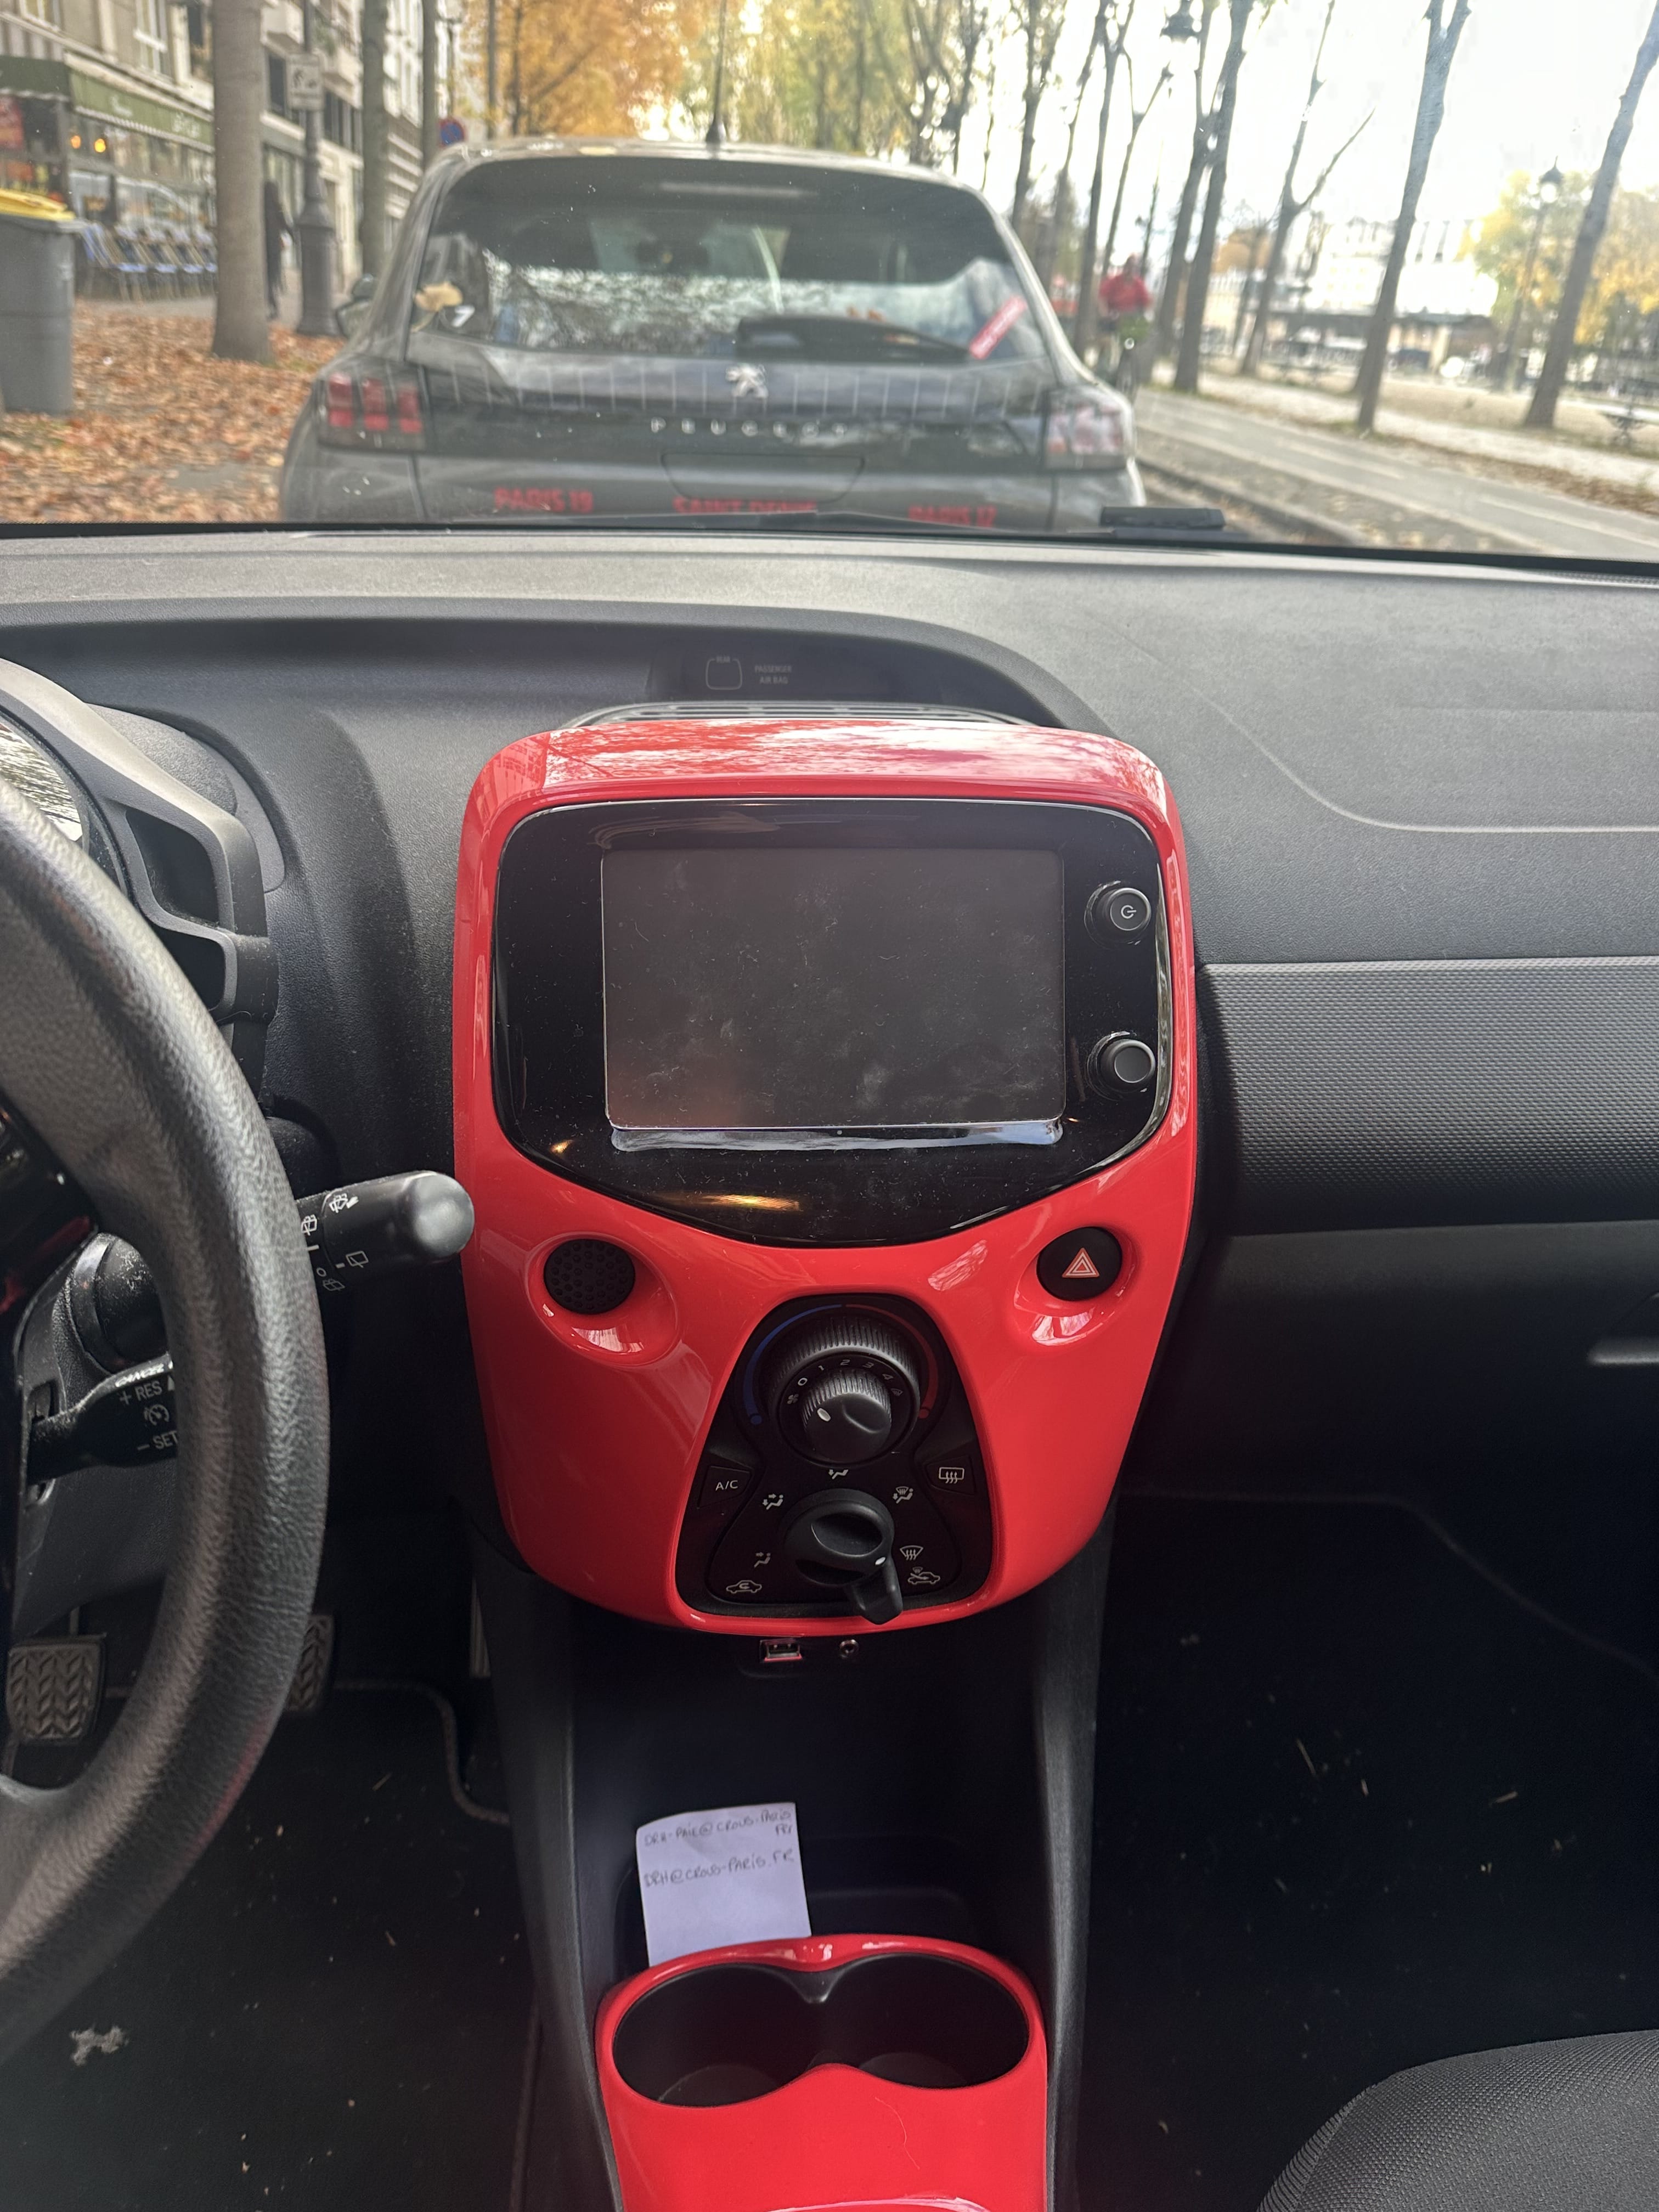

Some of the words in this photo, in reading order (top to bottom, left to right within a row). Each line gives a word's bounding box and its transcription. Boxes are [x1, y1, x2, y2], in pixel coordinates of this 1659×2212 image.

[882, 1373, 894, 1381] 4
[135, 1380, 163, 1401] RES
[153, 1431, 178, 1449] SET
[715, 1480, 738, 1491] A/C
